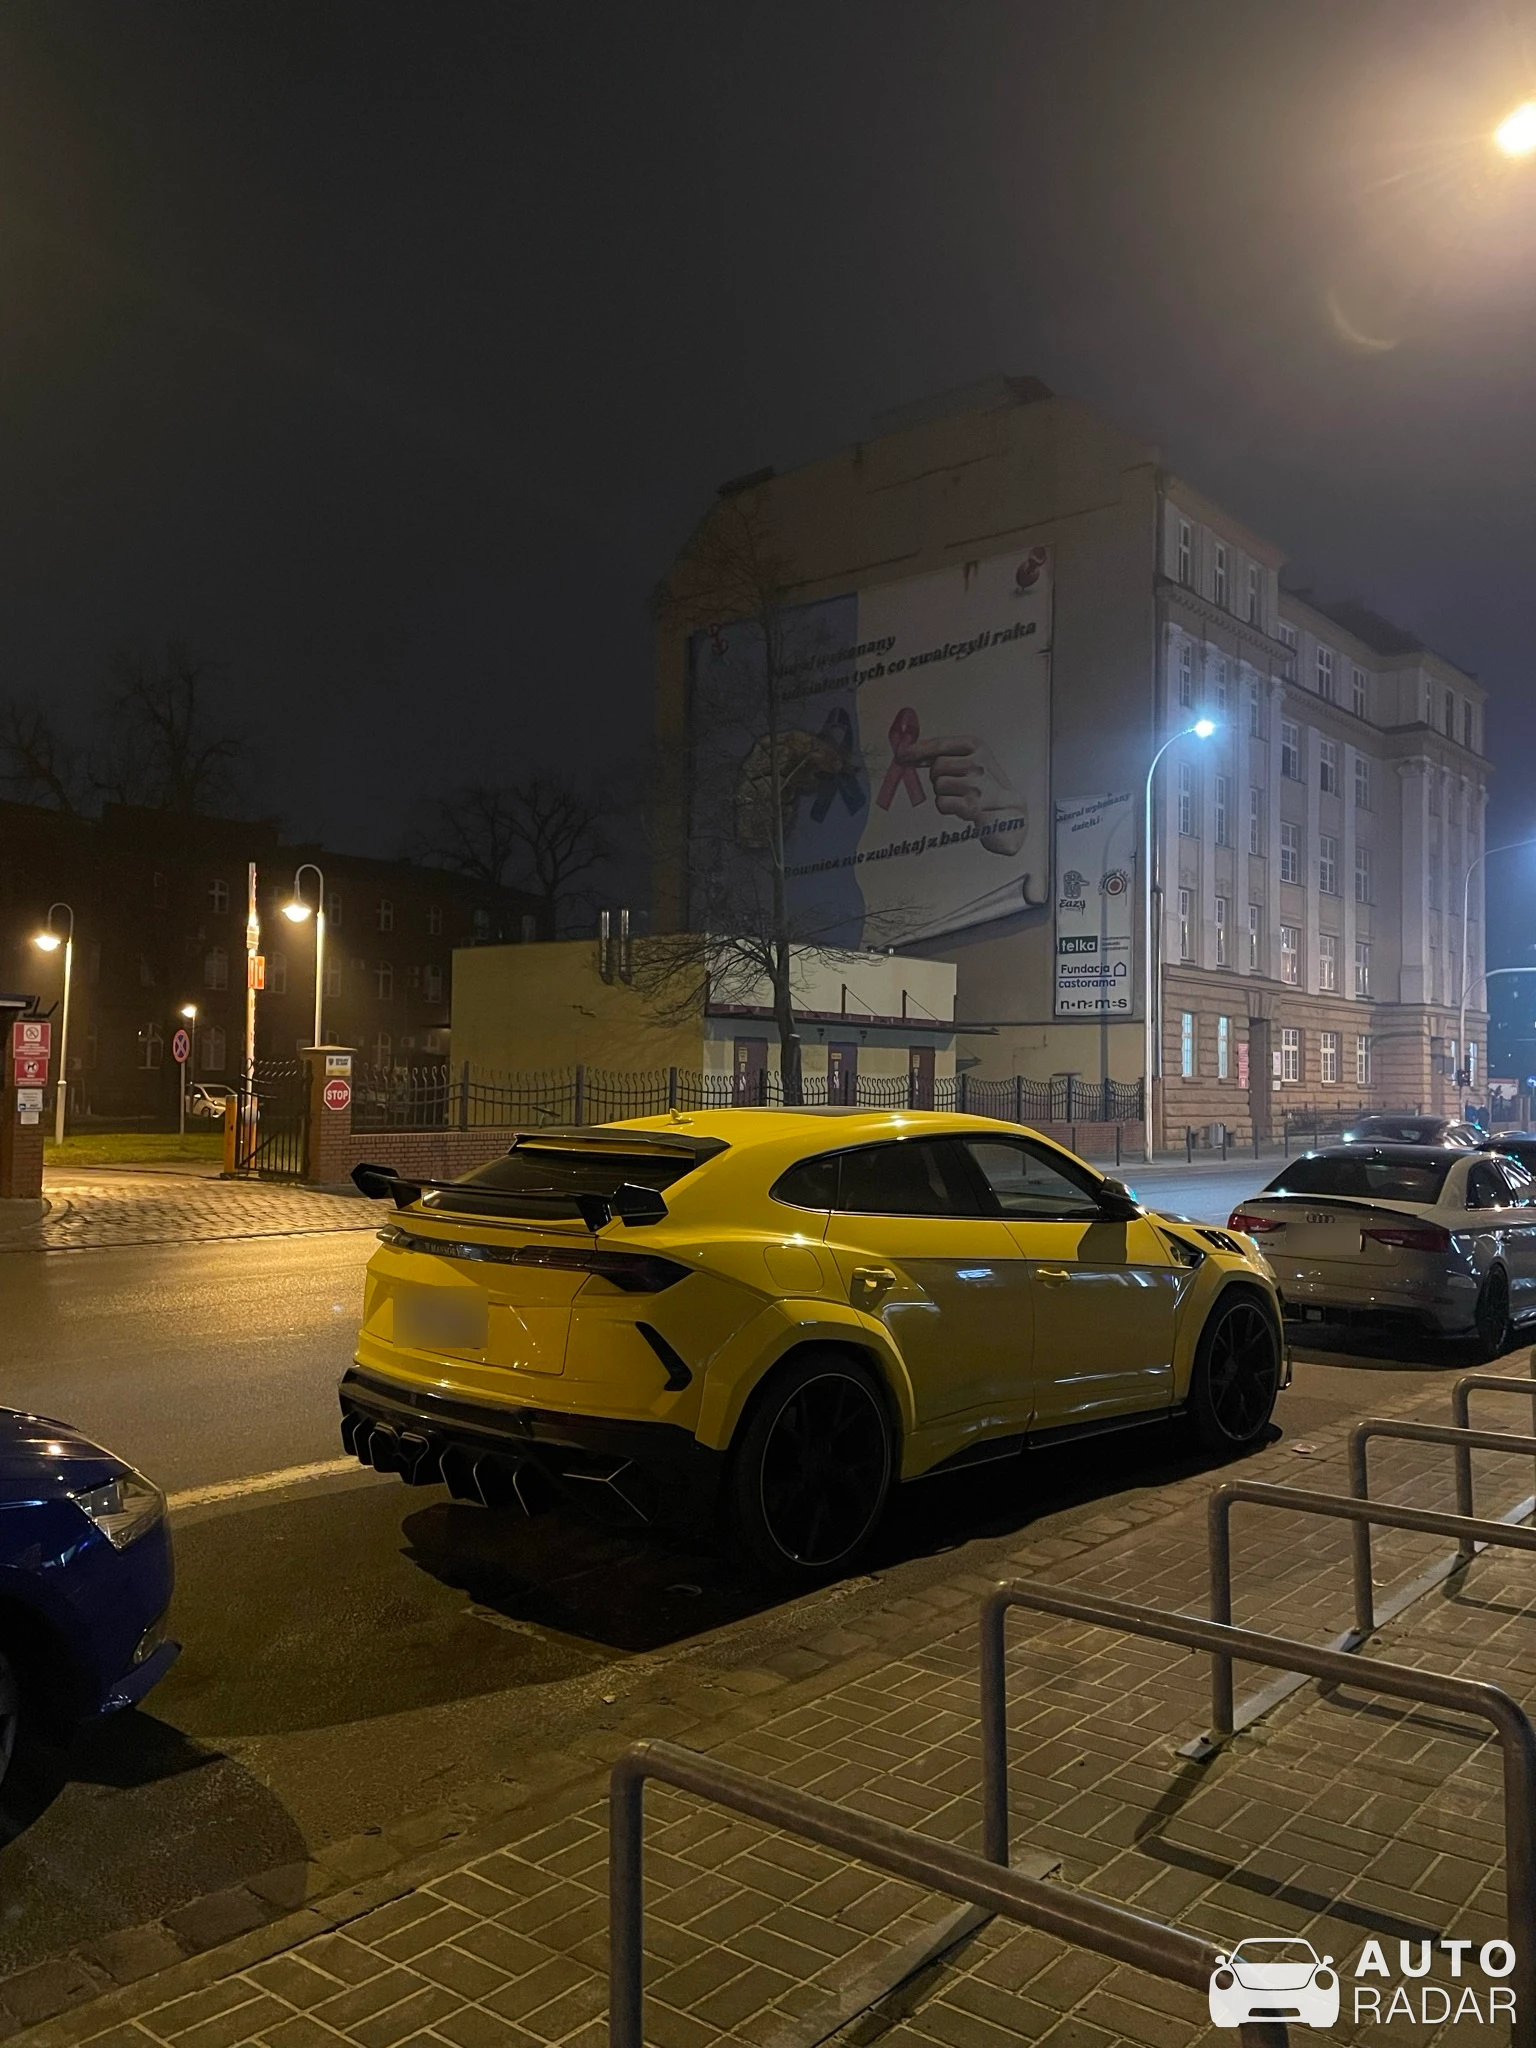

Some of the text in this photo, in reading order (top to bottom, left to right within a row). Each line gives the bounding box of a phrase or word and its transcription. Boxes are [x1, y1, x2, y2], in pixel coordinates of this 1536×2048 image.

[851, 661, 885, 690] tych
[887, 659, 906, 676] co
[991, 621, 1037, 646] raka
[841, 850, 865, 867] nie
[865, 835, 926, 862] zwlekaj
[926, 837, 939, 849] z
[938, 817, 1026, 847] badaniem
[1059, 898, 1086, 912] Eazy
[1061, 938, 1097, 952] telka
[1060, 962, 1111, 976] Fundacja
[1058, 978, 1117, 989] castorama
[326, 1089, 349, 1101] STOP
